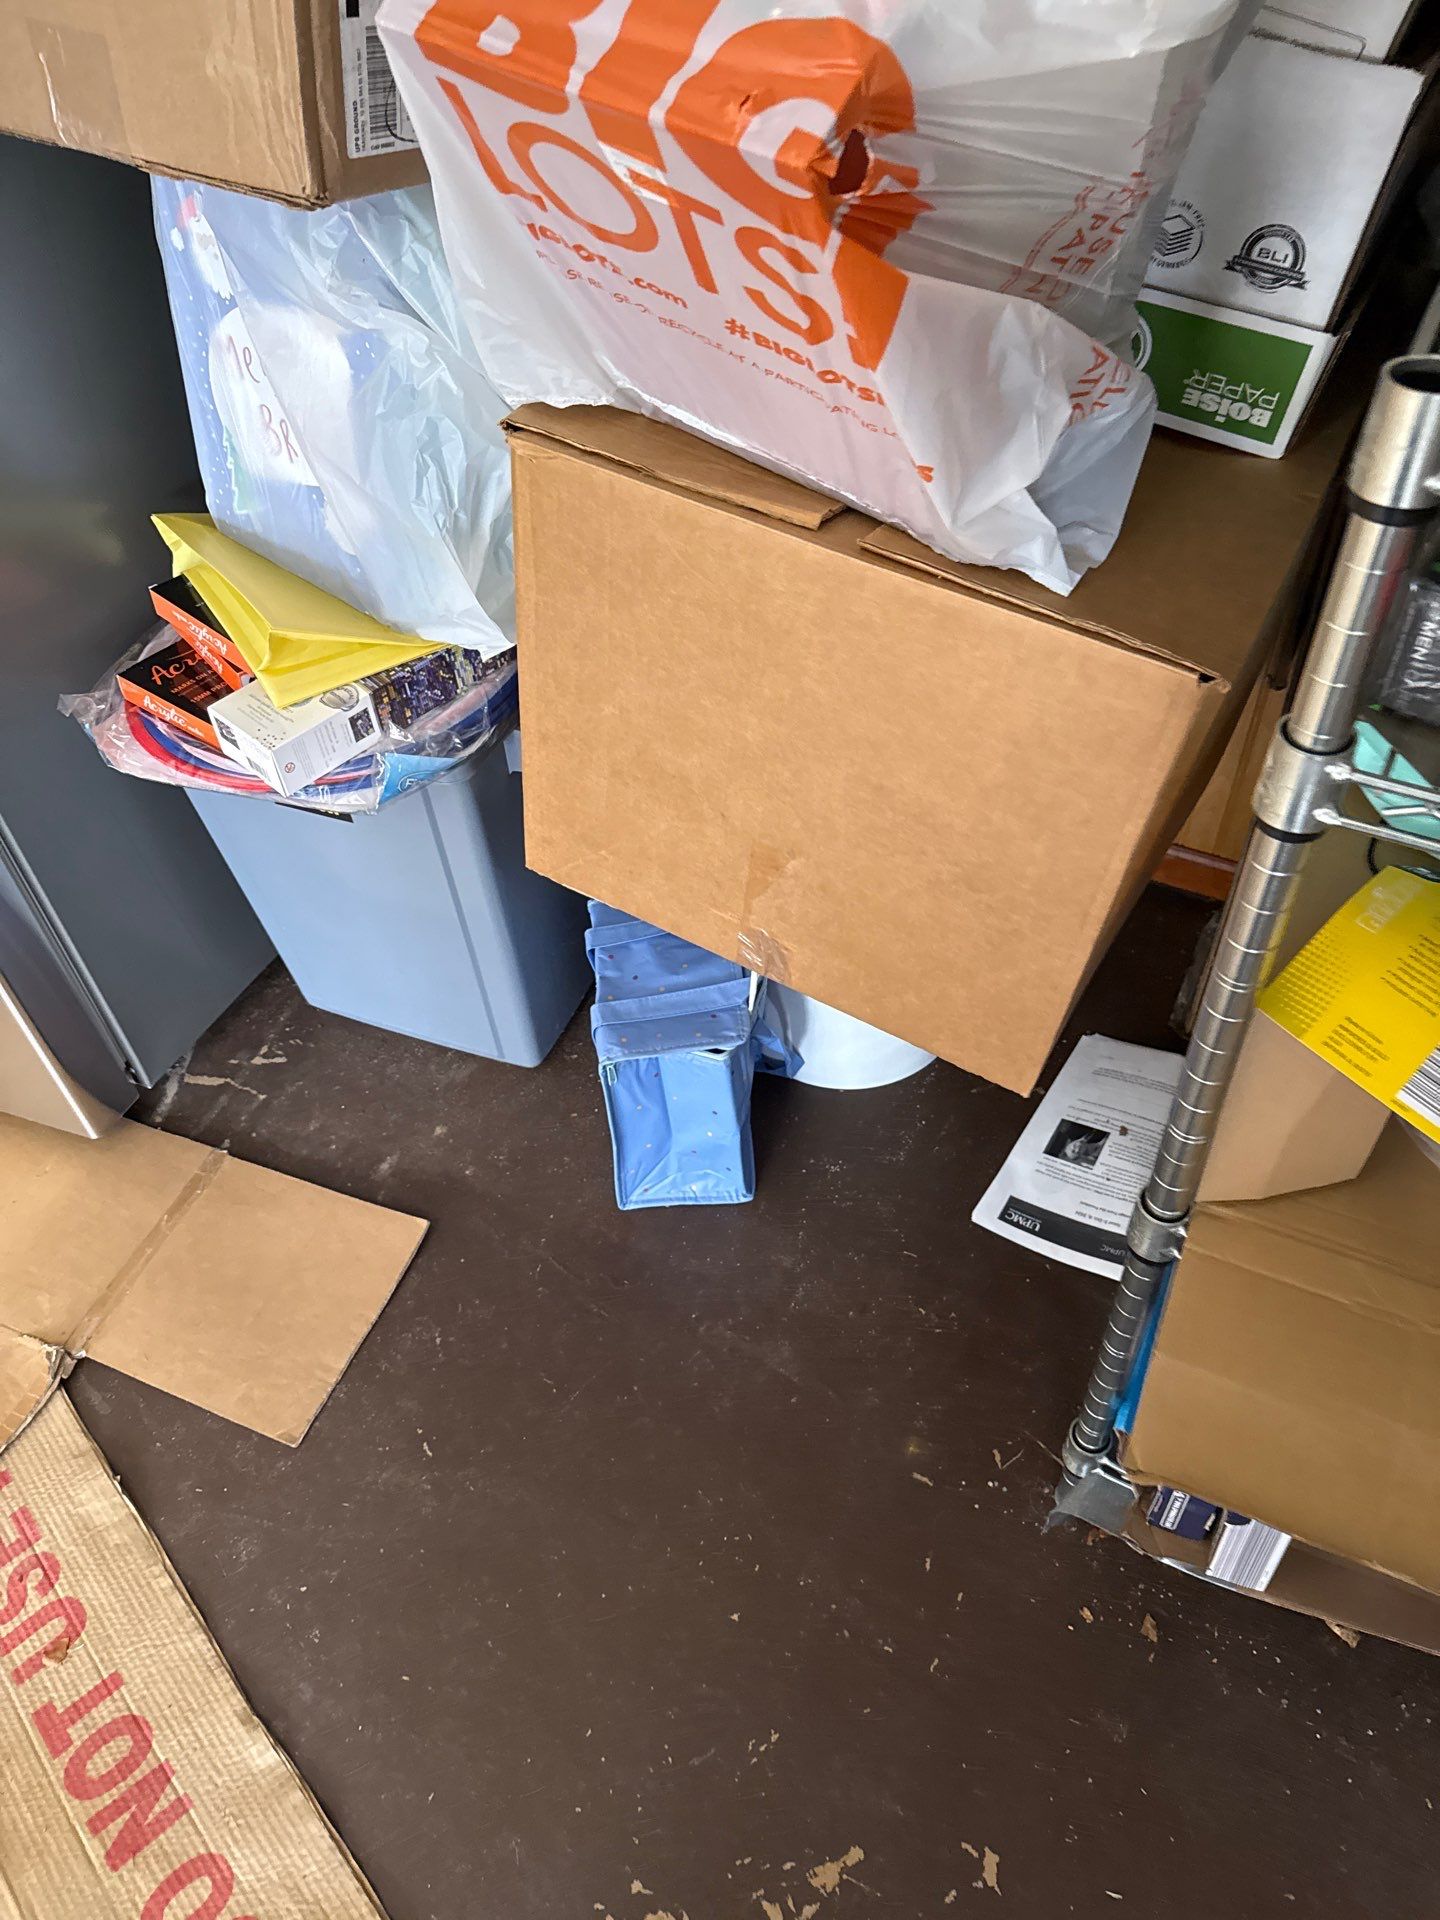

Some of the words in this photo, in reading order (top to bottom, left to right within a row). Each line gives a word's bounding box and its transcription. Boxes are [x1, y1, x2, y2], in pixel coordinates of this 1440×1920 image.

[414, 0, 919, 258] BIG
[1004, 1210, 1042, 1232] UPMC
[31, 1671, 194, 1873] NOT
